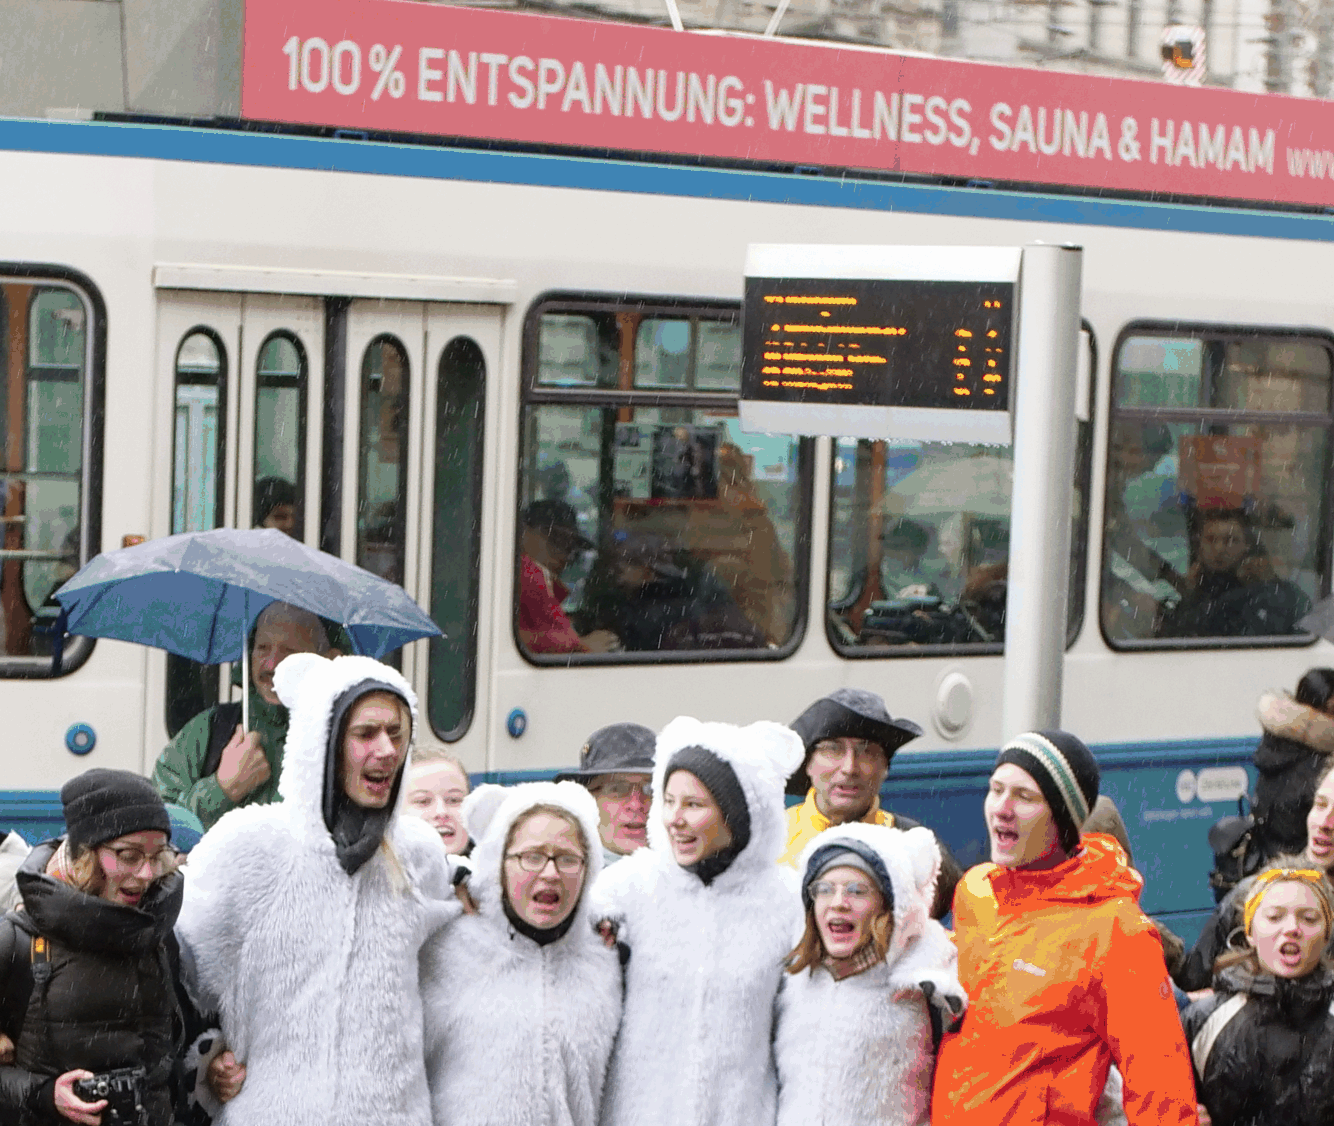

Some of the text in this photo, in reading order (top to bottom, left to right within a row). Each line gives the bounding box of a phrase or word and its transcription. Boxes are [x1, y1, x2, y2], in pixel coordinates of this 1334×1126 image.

[418, 46, 756, 127] ENTSPANNUNG:
[764, 80, 980, 155] WELLNESS,
[989, 102, 1113, 160] SAUNA
[1118, 116, 1142, 162] &
[1150, 117, 1276, 175] HAMAM
